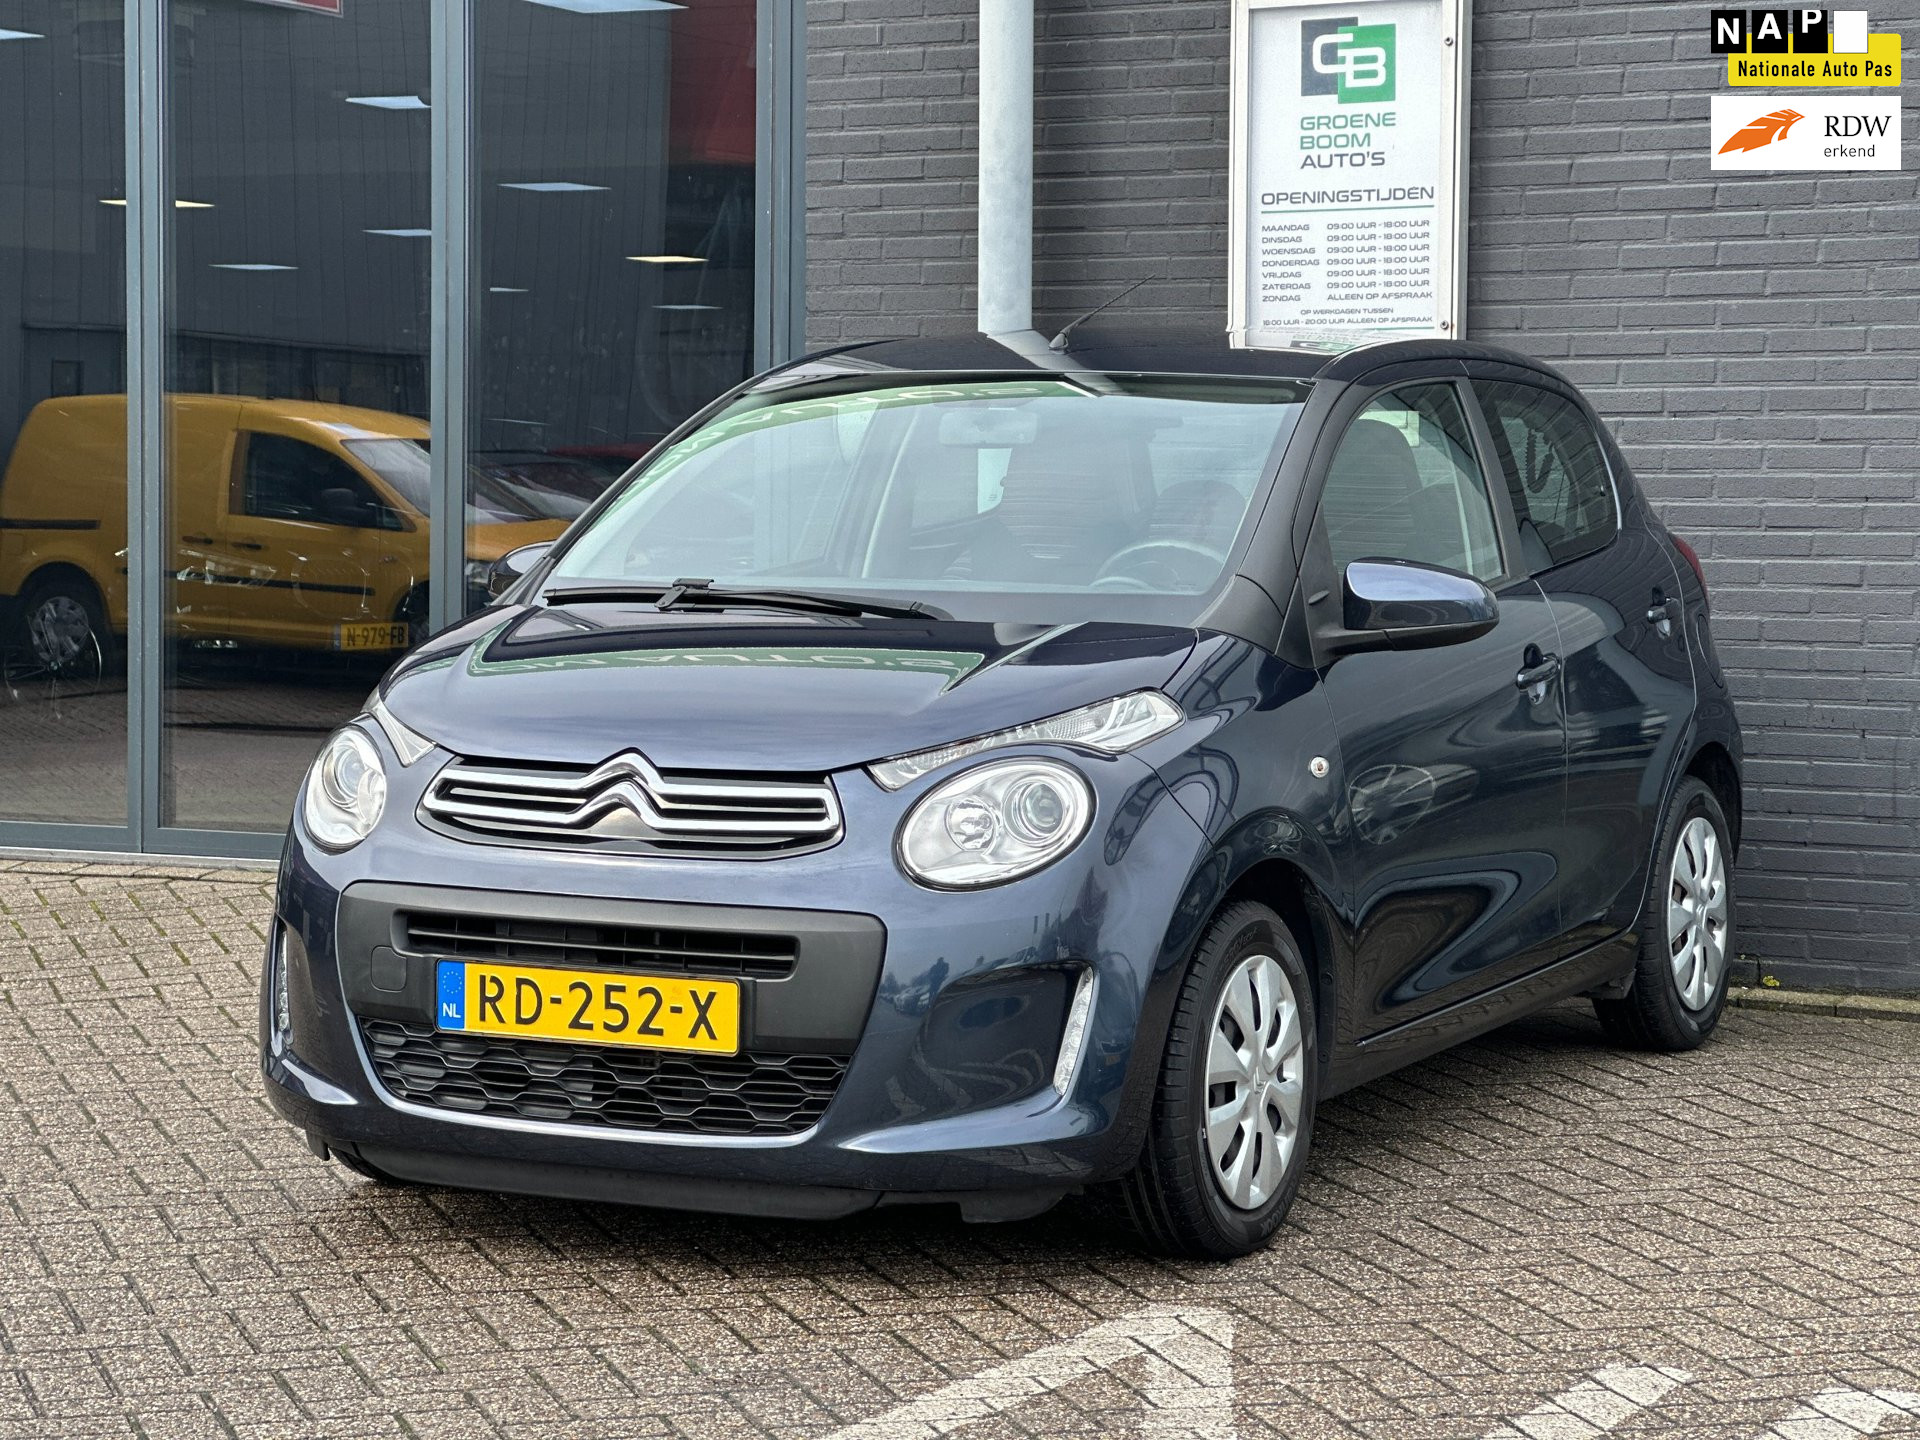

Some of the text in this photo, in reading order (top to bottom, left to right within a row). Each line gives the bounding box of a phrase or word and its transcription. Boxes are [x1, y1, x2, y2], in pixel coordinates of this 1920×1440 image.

[1300, 112, 1396, 130] GROENE
[1300, 133, 1371, 150] BOOM
[1300, 152, 1385, 169] AUTO'S
[1261, 186, 1434, 205] OPENINGSTIJDEN
[1262, 224, 1310, 232] MAANDAG
[1327, 222, 1354, 230] 09:00
[1356, 221, 1376, 229] UUR
[1384, 244, 1407, 252] 18:00
[1262, 259, 1320, 267] DONDERDAG
[1356, 256, 1376, 264] UUR
[1327, 269, 1354, 277] 09:00
[1356, 268, 1376, 276] UUR
[347, 626, 405, 646] N-979-FB
[442, 1003, 461, 1018] NL
[478, 974, 719, 1041] RD-252-X
